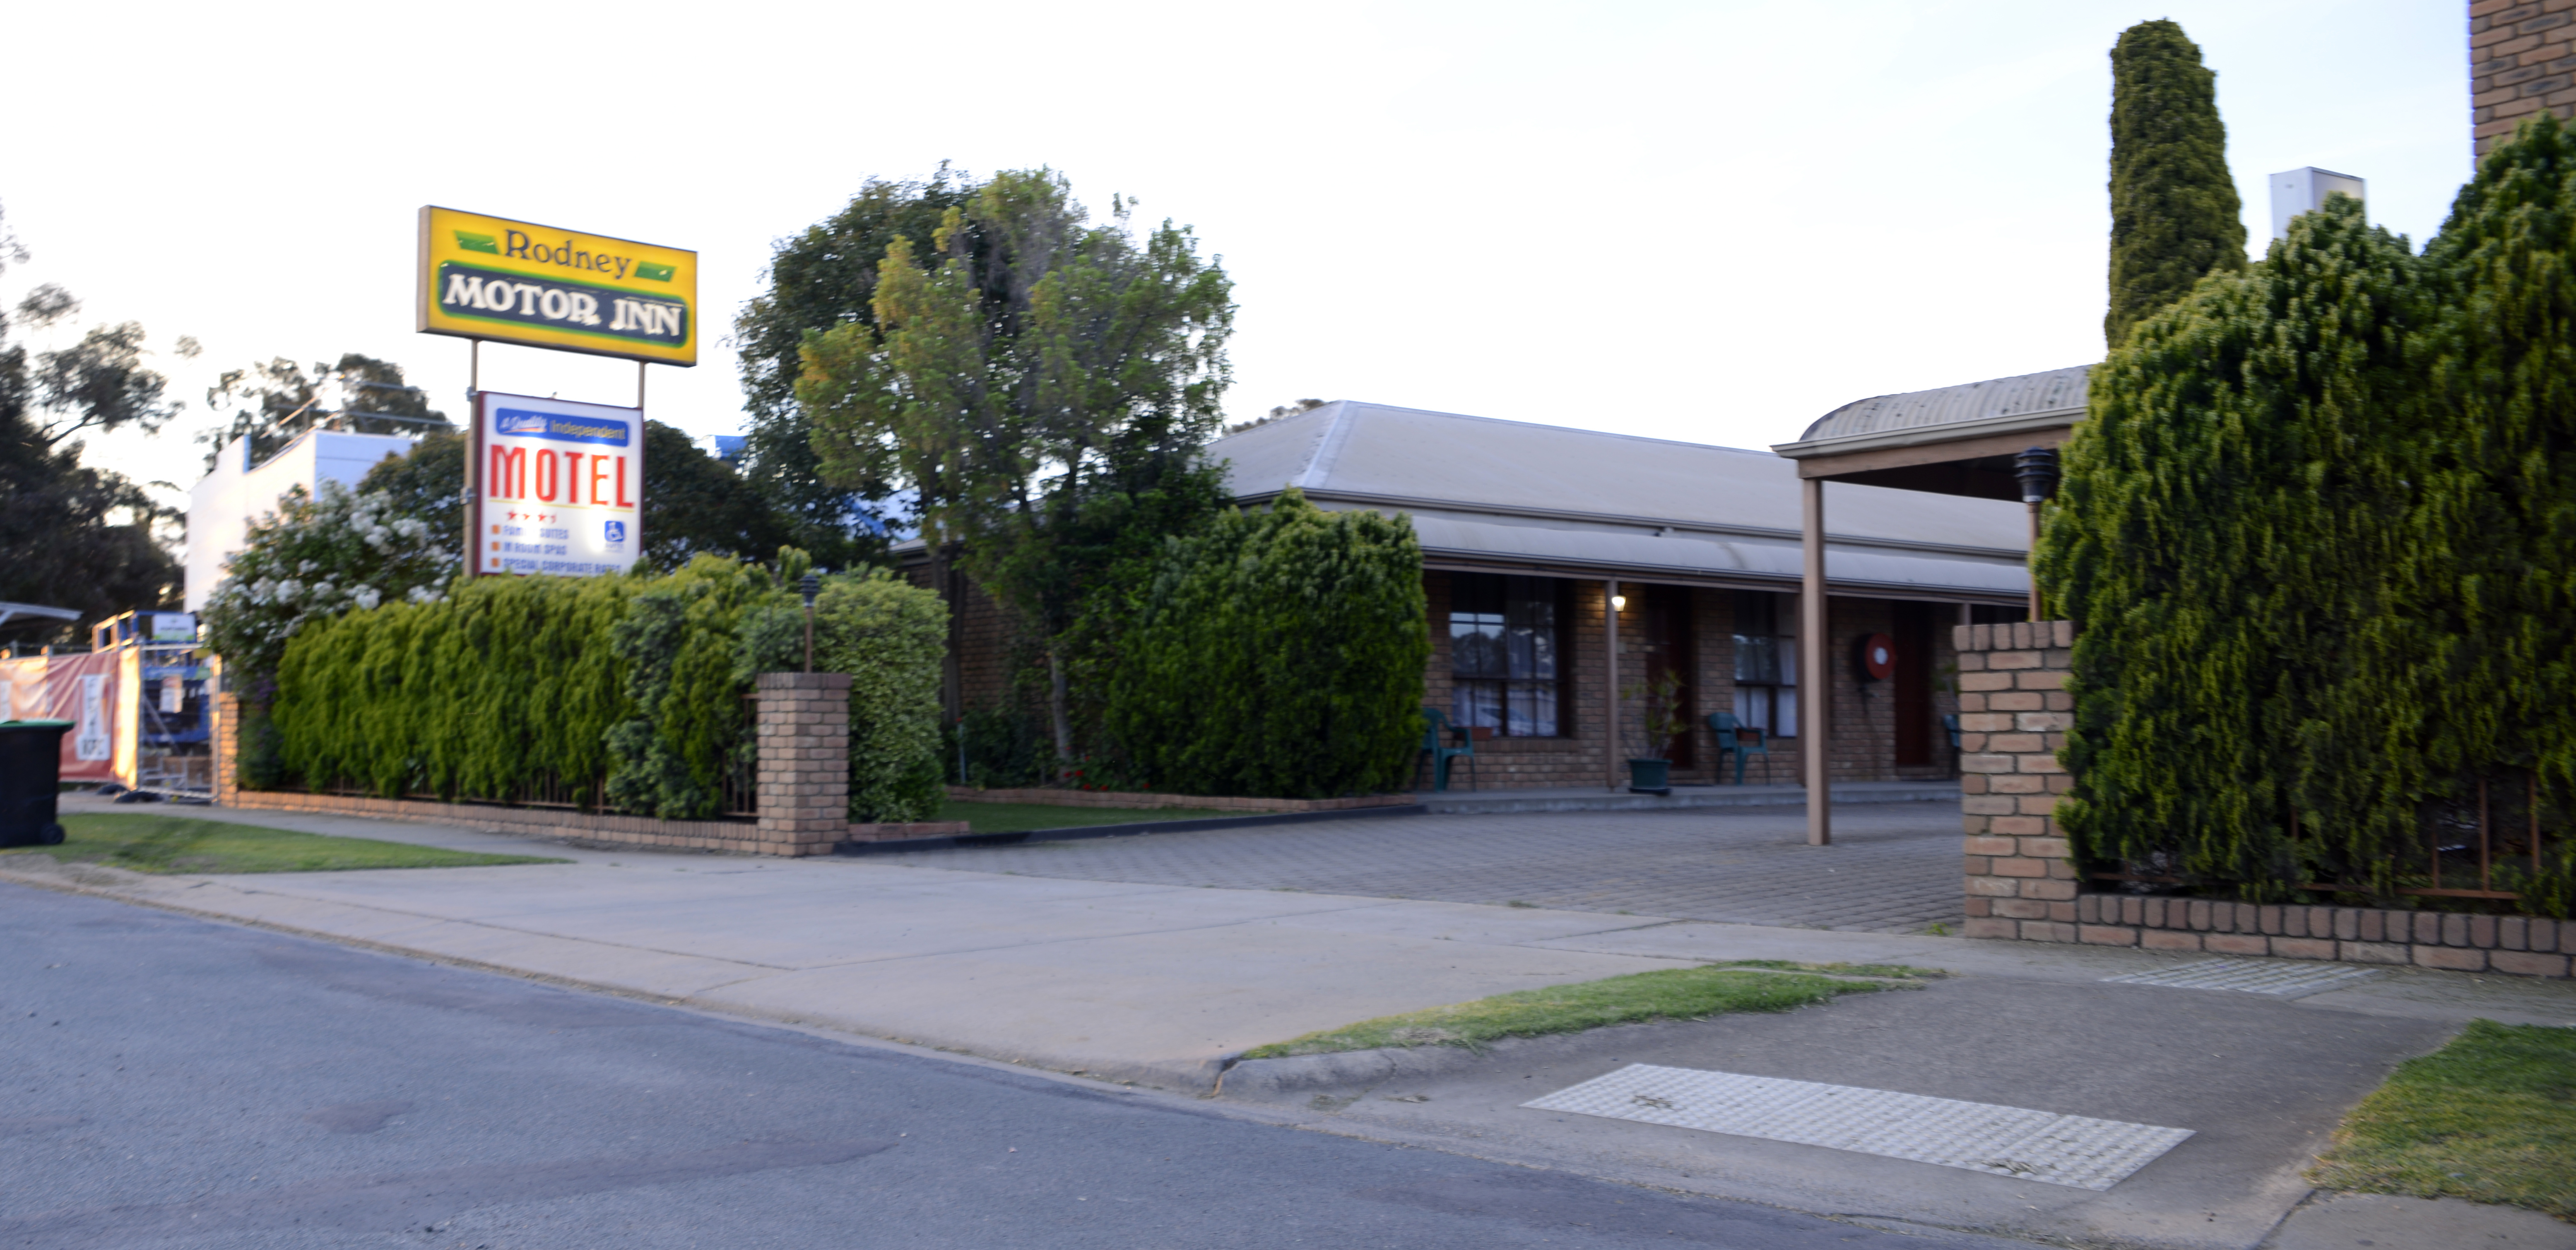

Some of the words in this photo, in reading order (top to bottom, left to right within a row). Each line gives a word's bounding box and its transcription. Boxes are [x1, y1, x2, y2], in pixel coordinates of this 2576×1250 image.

[505, 229, 631, 279] Rodney
[443, 273, 602, 326] MOTOR
[609, 298, 681, 336] INN
[510, 415, 547, 431] Quality
[550, 419, 626, 440] Independent
[490, 444, 635, 508] MOTEL
[539, 528, 569, 539] SUITES
